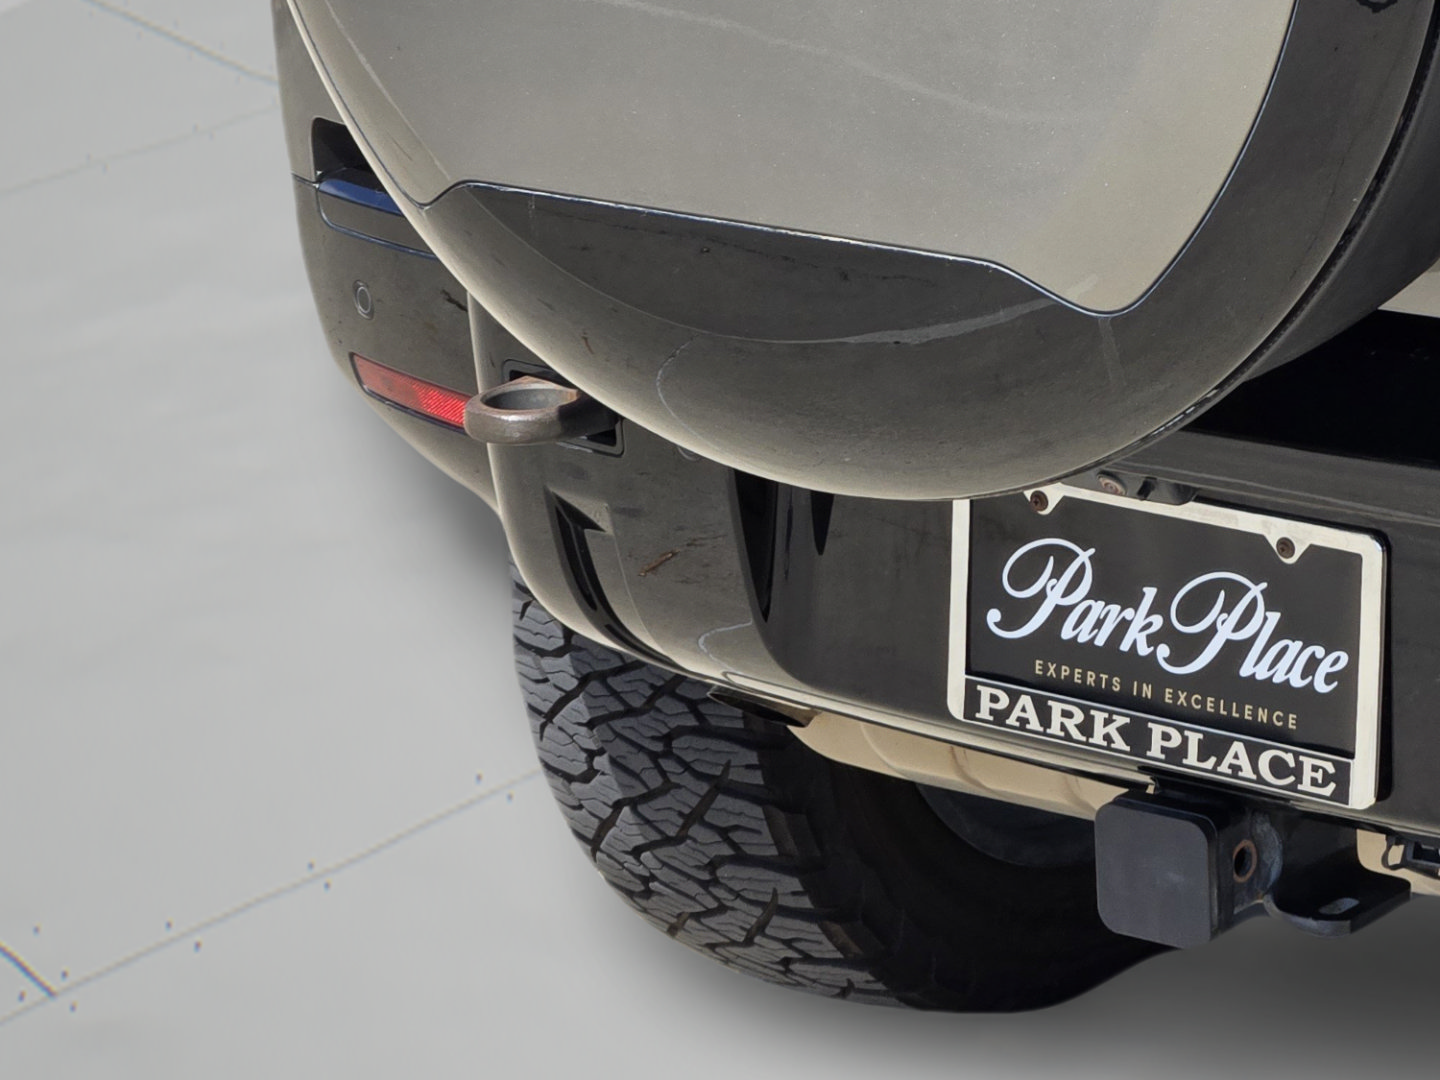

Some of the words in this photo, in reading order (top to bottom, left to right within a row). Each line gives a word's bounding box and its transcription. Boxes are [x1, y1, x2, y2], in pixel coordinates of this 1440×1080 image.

[986, 538, 1163, 656] Park
[1156, 572, 1349, 693] Place
[975, 684, 1131, 753] PARK
[1146, 721, 1337, 798] PLACE
[1034, 659, 1122, 692] EXPERTS
[1133, 681, 1153, 700] IN
[1164, 688, 1298, 730] EXCELLENCE
